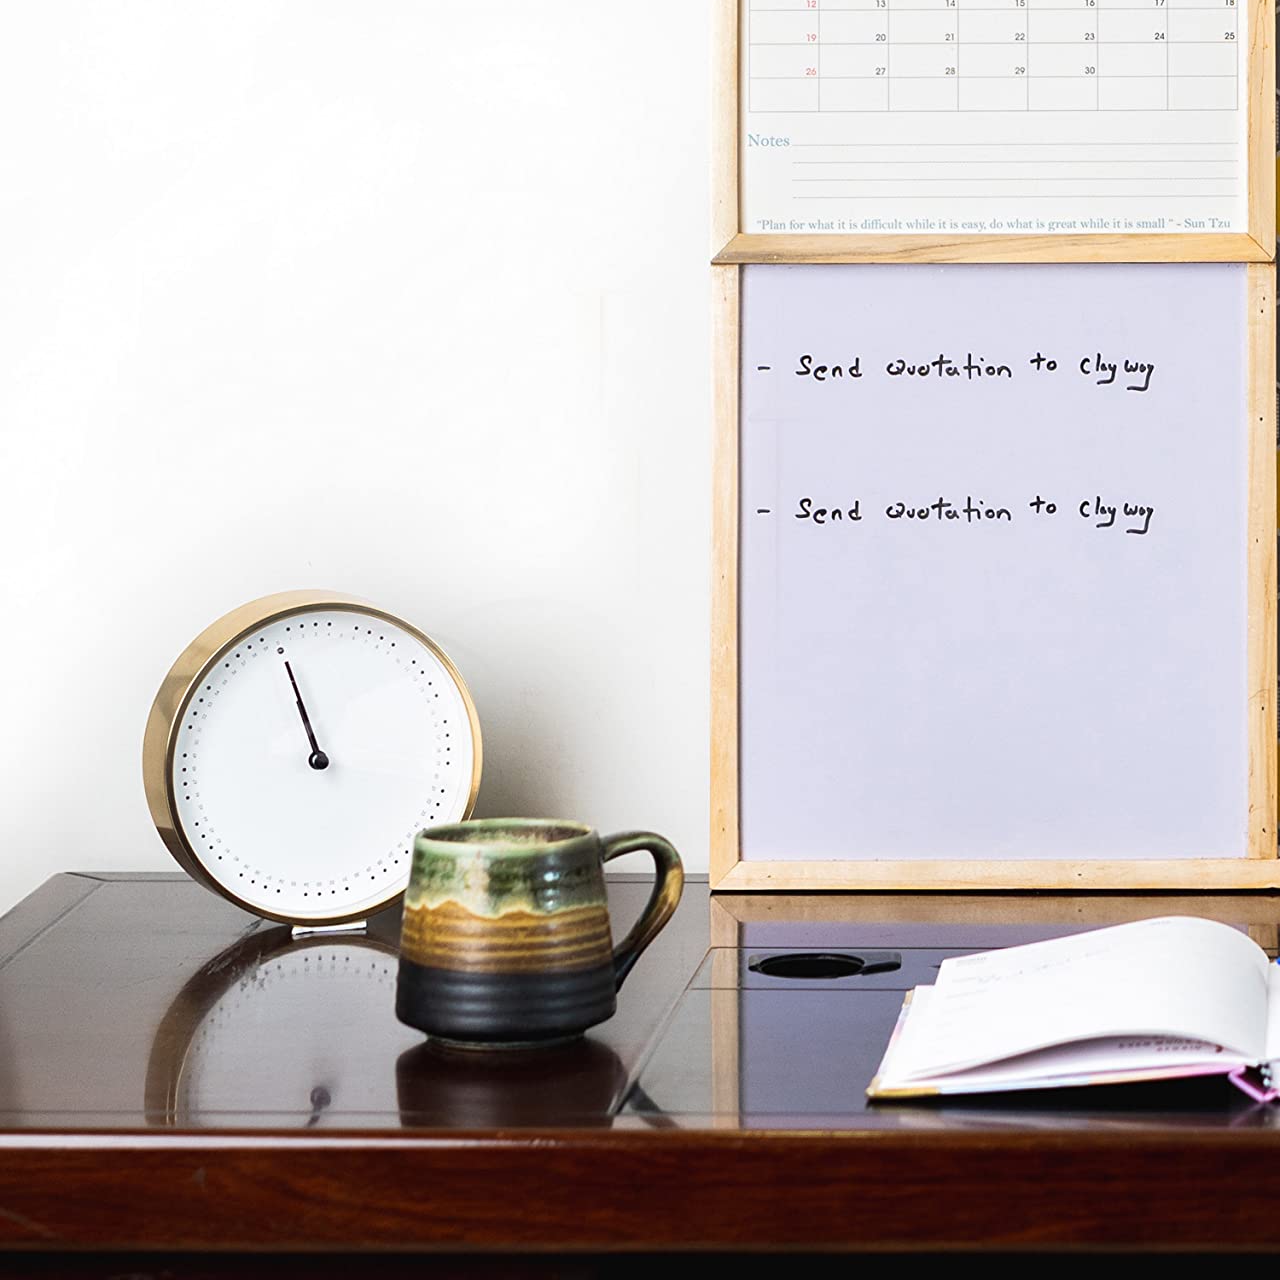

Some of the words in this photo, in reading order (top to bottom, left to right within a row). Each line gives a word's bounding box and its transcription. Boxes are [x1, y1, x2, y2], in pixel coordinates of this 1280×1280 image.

[806, 0, 817, 9] 12
[876, 0, 887, 8] 13
[945, 0, 956, 7] 14
[1015, 0, 1026, 8] 15
[806, 33, 817, 42] 19
[875, 33, 887, 42] 20
[945, 33, 955, 42] 21
[1014, 32, 1026, 41] 22
[1084, 32, 1096, 41] 23
[1154, 32, 1165, 41] 24
[1224, 31, 1236, 40] 25
[805, 67, 817, 76] 26
[875, 67, 886, 76] 27
[945, 67, 956, 75] 28
[1015, 66, 1026, 75] 29
[1084, 66, 1096, 75] 30
[747, 133, 791, 148] Notes
[789, 219, 806, 230] for
[808, 218, 835, 230] what
[837, 218, 846, 230] it
[848, 219, 858, 230] is
[860, 218, 903, 230] difficult
[905, 218, 936, 230] while
[938, 218, 947, 230] it
[949, 218, 959, 230] is
[961, 221, 987, 233] easy,
[989, 218, 1004, 229] do
[1006, 218, 1033, 229] what
[1036, 218, 1046, 229] is
[1047, 220, 1077, 232] great
[1080, 217, 1110, 229] while
[1112, 217, 1121, 229] it
[1124, 217, 1134, 229] is
[1136, 217, 1165, 229] small
[1182, 218, 1207, 229] Sun
[1207, 217, 1231, 229] Tzu
[795, 354, 863, 382] Send
[1029, 351, 1058, 372] to
[794, 497, 863, 525] Send
[1029, 495, 1057, 515] to
